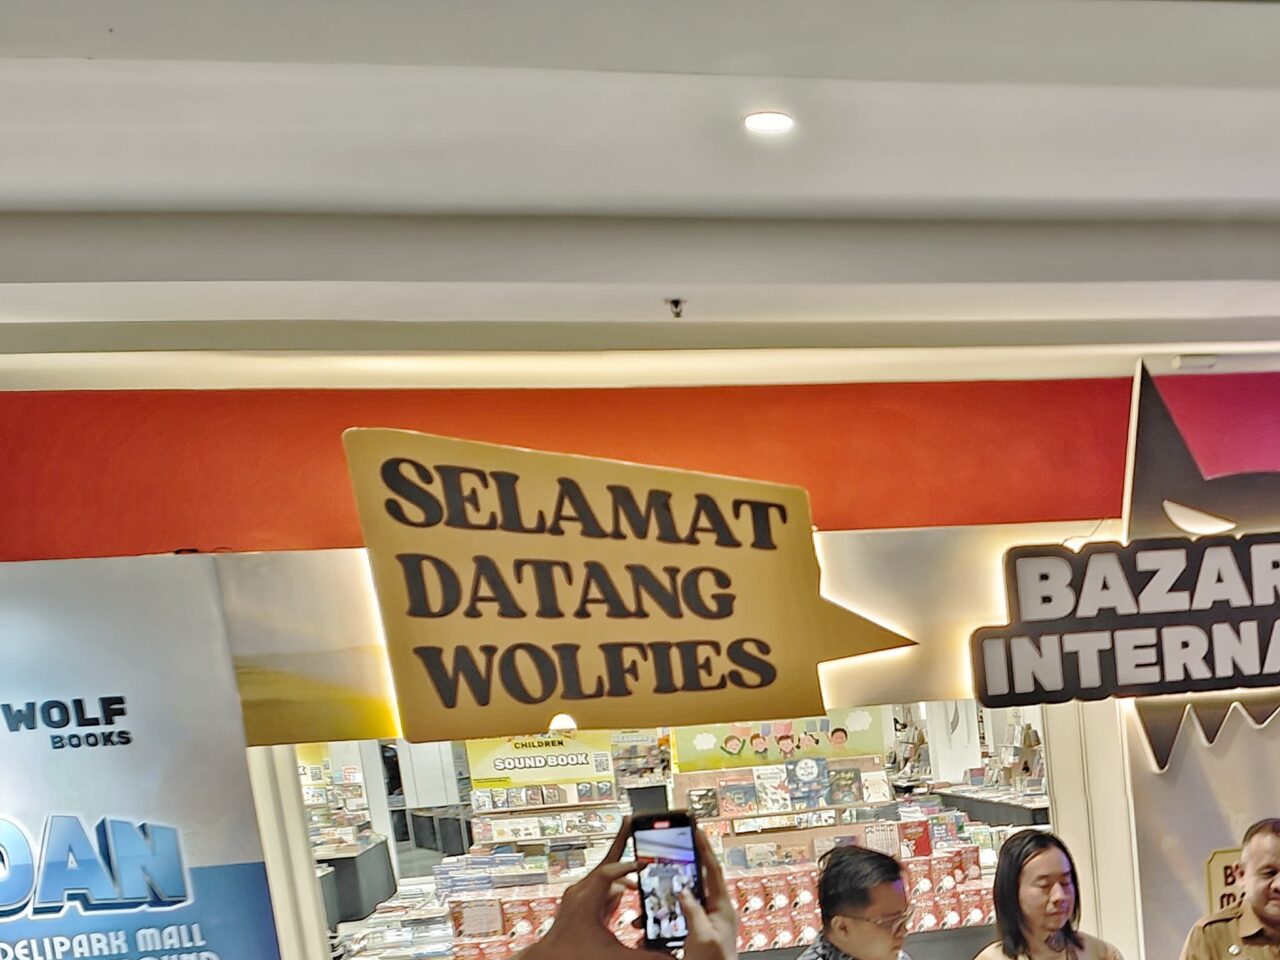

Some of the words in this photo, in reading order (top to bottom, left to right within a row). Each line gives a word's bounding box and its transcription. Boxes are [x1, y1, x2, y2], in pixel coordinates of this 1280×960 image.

[381, 457, 788, 550] SELAMAT
[395, 552, 737, 620] DATANG
[413, 637, 777, 709] WOLFIES
[1, 696, 128, 732] WOLF
[50, 730, 133, 750] BOOKS
[513, 739, 564, 750] CHILDREN
[493, 755, 545, 771] SOUND
[549, 752, 590, 768] BOOK
[136, 923, 207, 953] MALL
